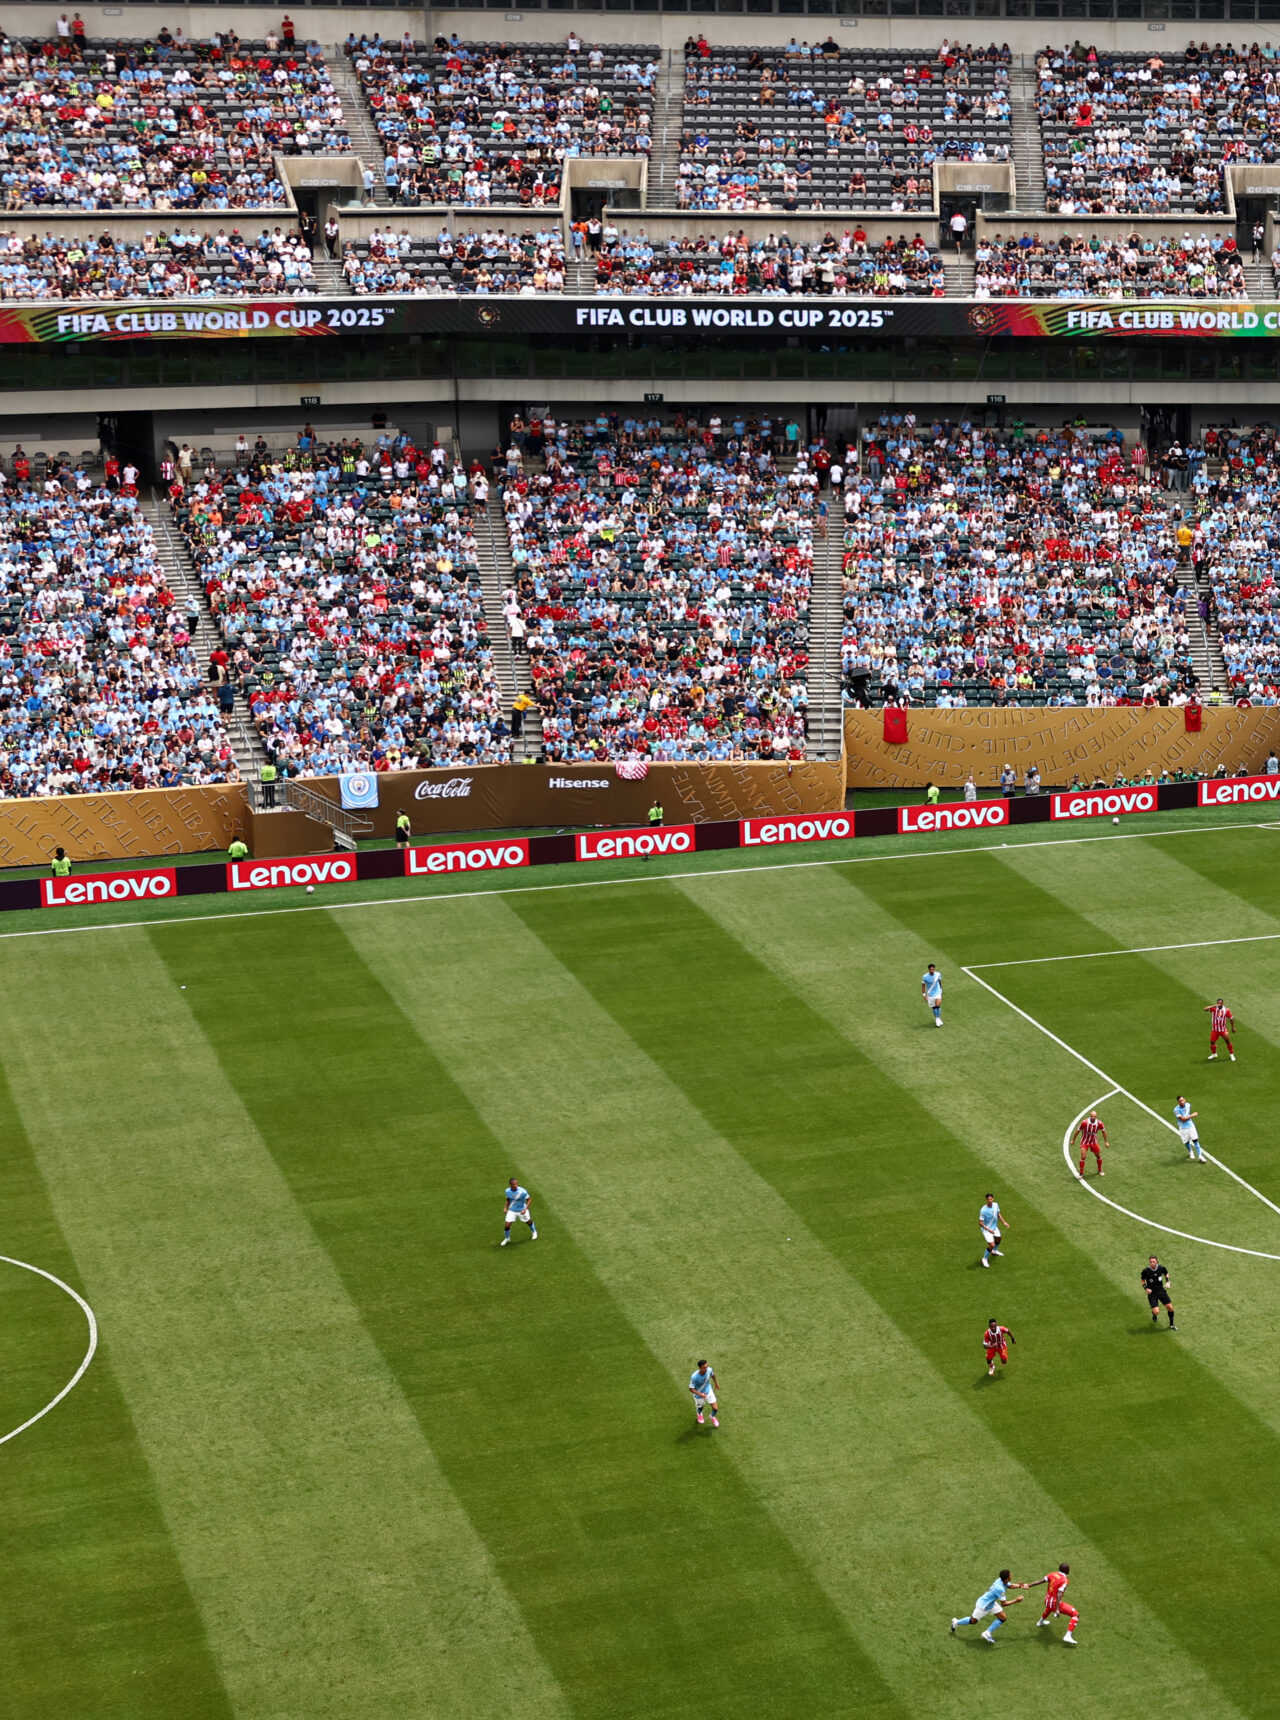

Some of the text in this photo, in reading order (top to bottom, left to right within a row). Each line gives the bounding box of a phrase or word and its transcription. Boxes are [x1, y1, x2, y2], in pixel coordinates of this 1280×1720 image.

[59, 315, 111, 333] FIFA
[116, 313, 179, 331] CLUB
[186, 311, 271, 330] WORLD
[277, 310, 323, 328] CUP
[577, 308, 625, 326] FIFA
[629, 309, 687, 326] CLUB
[692, 309, 775, 327] WORLD
[779, 310, 823, 327] CUP
[1067, 311, 1111, 328] FIFA
[1118, 311, 1174, 329] CLUB
[1179, 311, 1259, 329] WORLD
[414, 778, 474, 800] Coca-Cola
[549, 778, 609, 788] Hisense
[1055, 793, 1153, 817] Lenovo
[903, 806, 1003, 831] Lenovo
[745, 819, 850, 844] Lenovo
[580, 832, 690, 859] Lenovo
[411, 846, 524, 873] Lenovo
[233, 861, 351, 888] Lenovo
[47, 876, 171, 904] Lenovo
